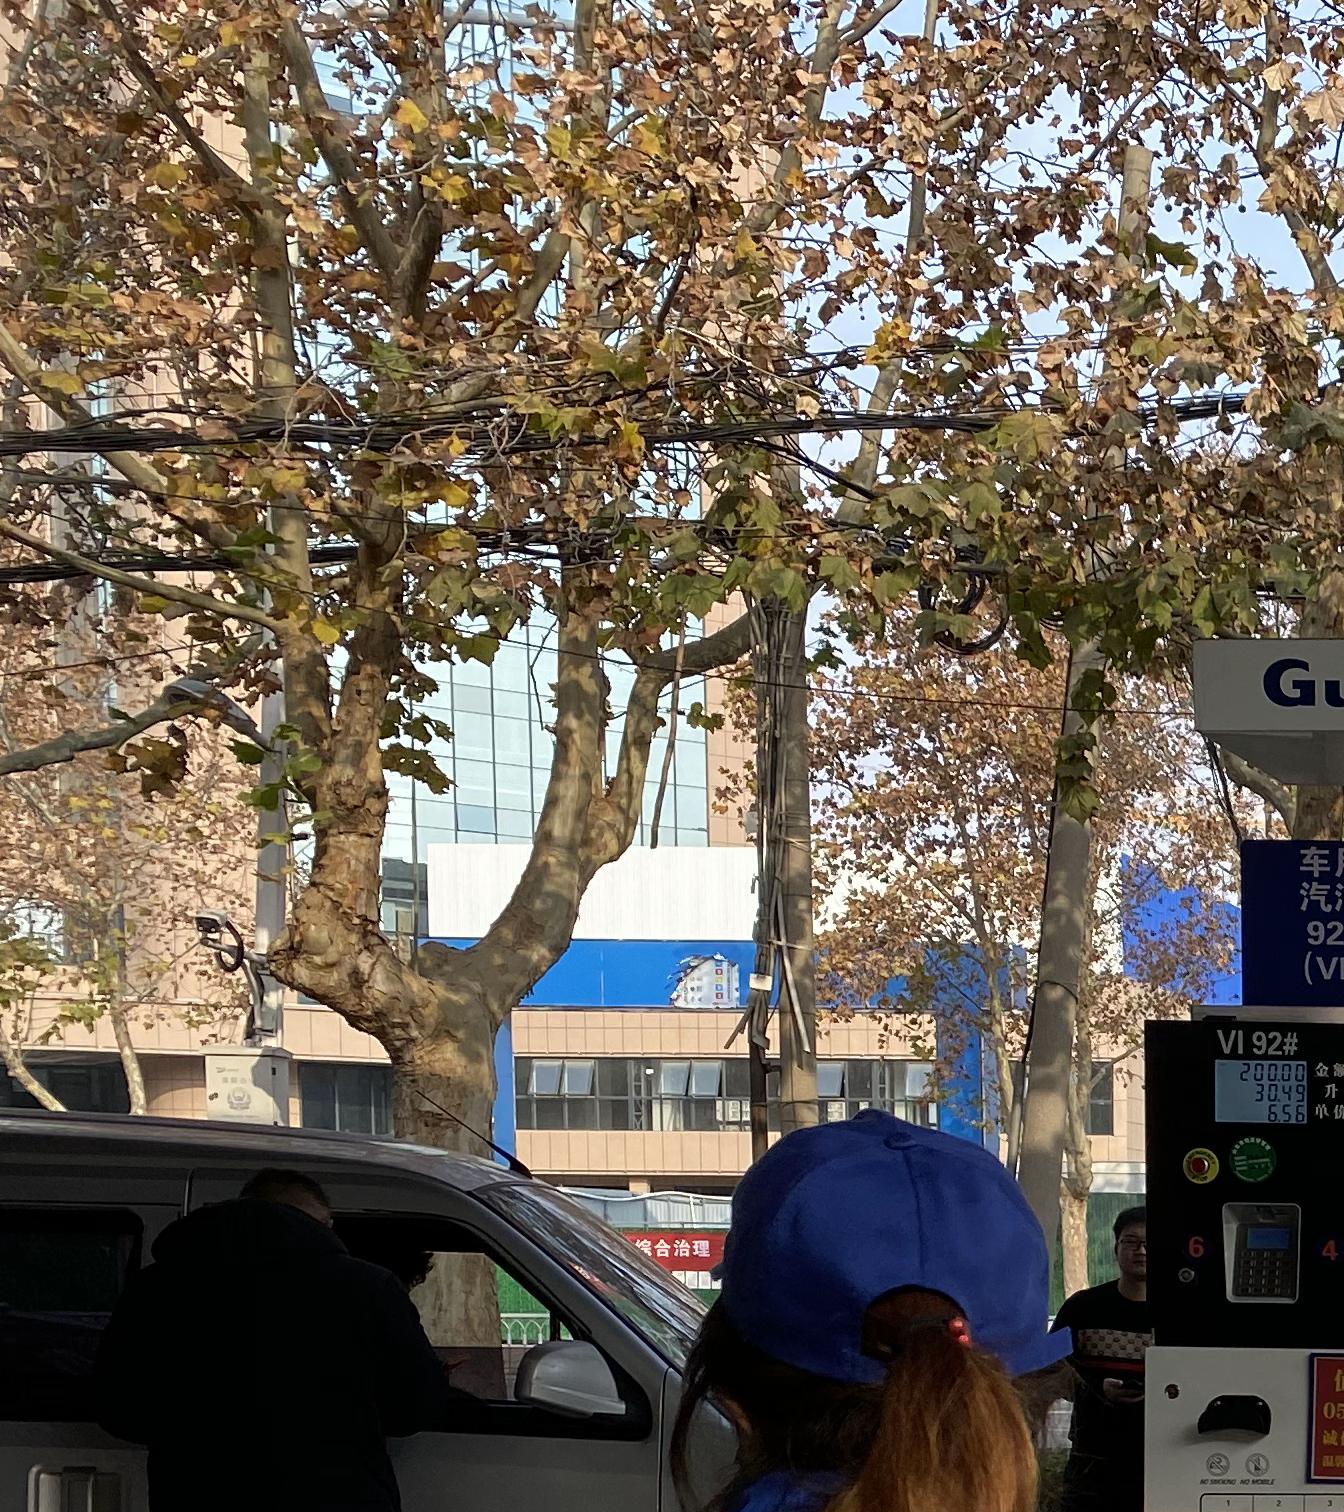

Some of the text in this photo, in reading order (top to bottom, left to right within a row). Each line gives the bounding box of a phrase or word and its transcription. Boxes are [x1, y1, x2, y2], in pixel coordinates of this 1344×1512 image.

[1217, 1030, 1299, 1056] VI 92#
[1239, 1062, 1306, 1082] 200.00
[1254, 1083, 1306, 1102] 30.49
[1324, 1083, 1338, 1099] 升
[1267, 1104, 1306, 1122] 6.56
[635, 1238, 711, 1258] 综合治理
[1188, 1236, 1204, 1258] 6
[1321, 1239, 1339, 1261] 4
